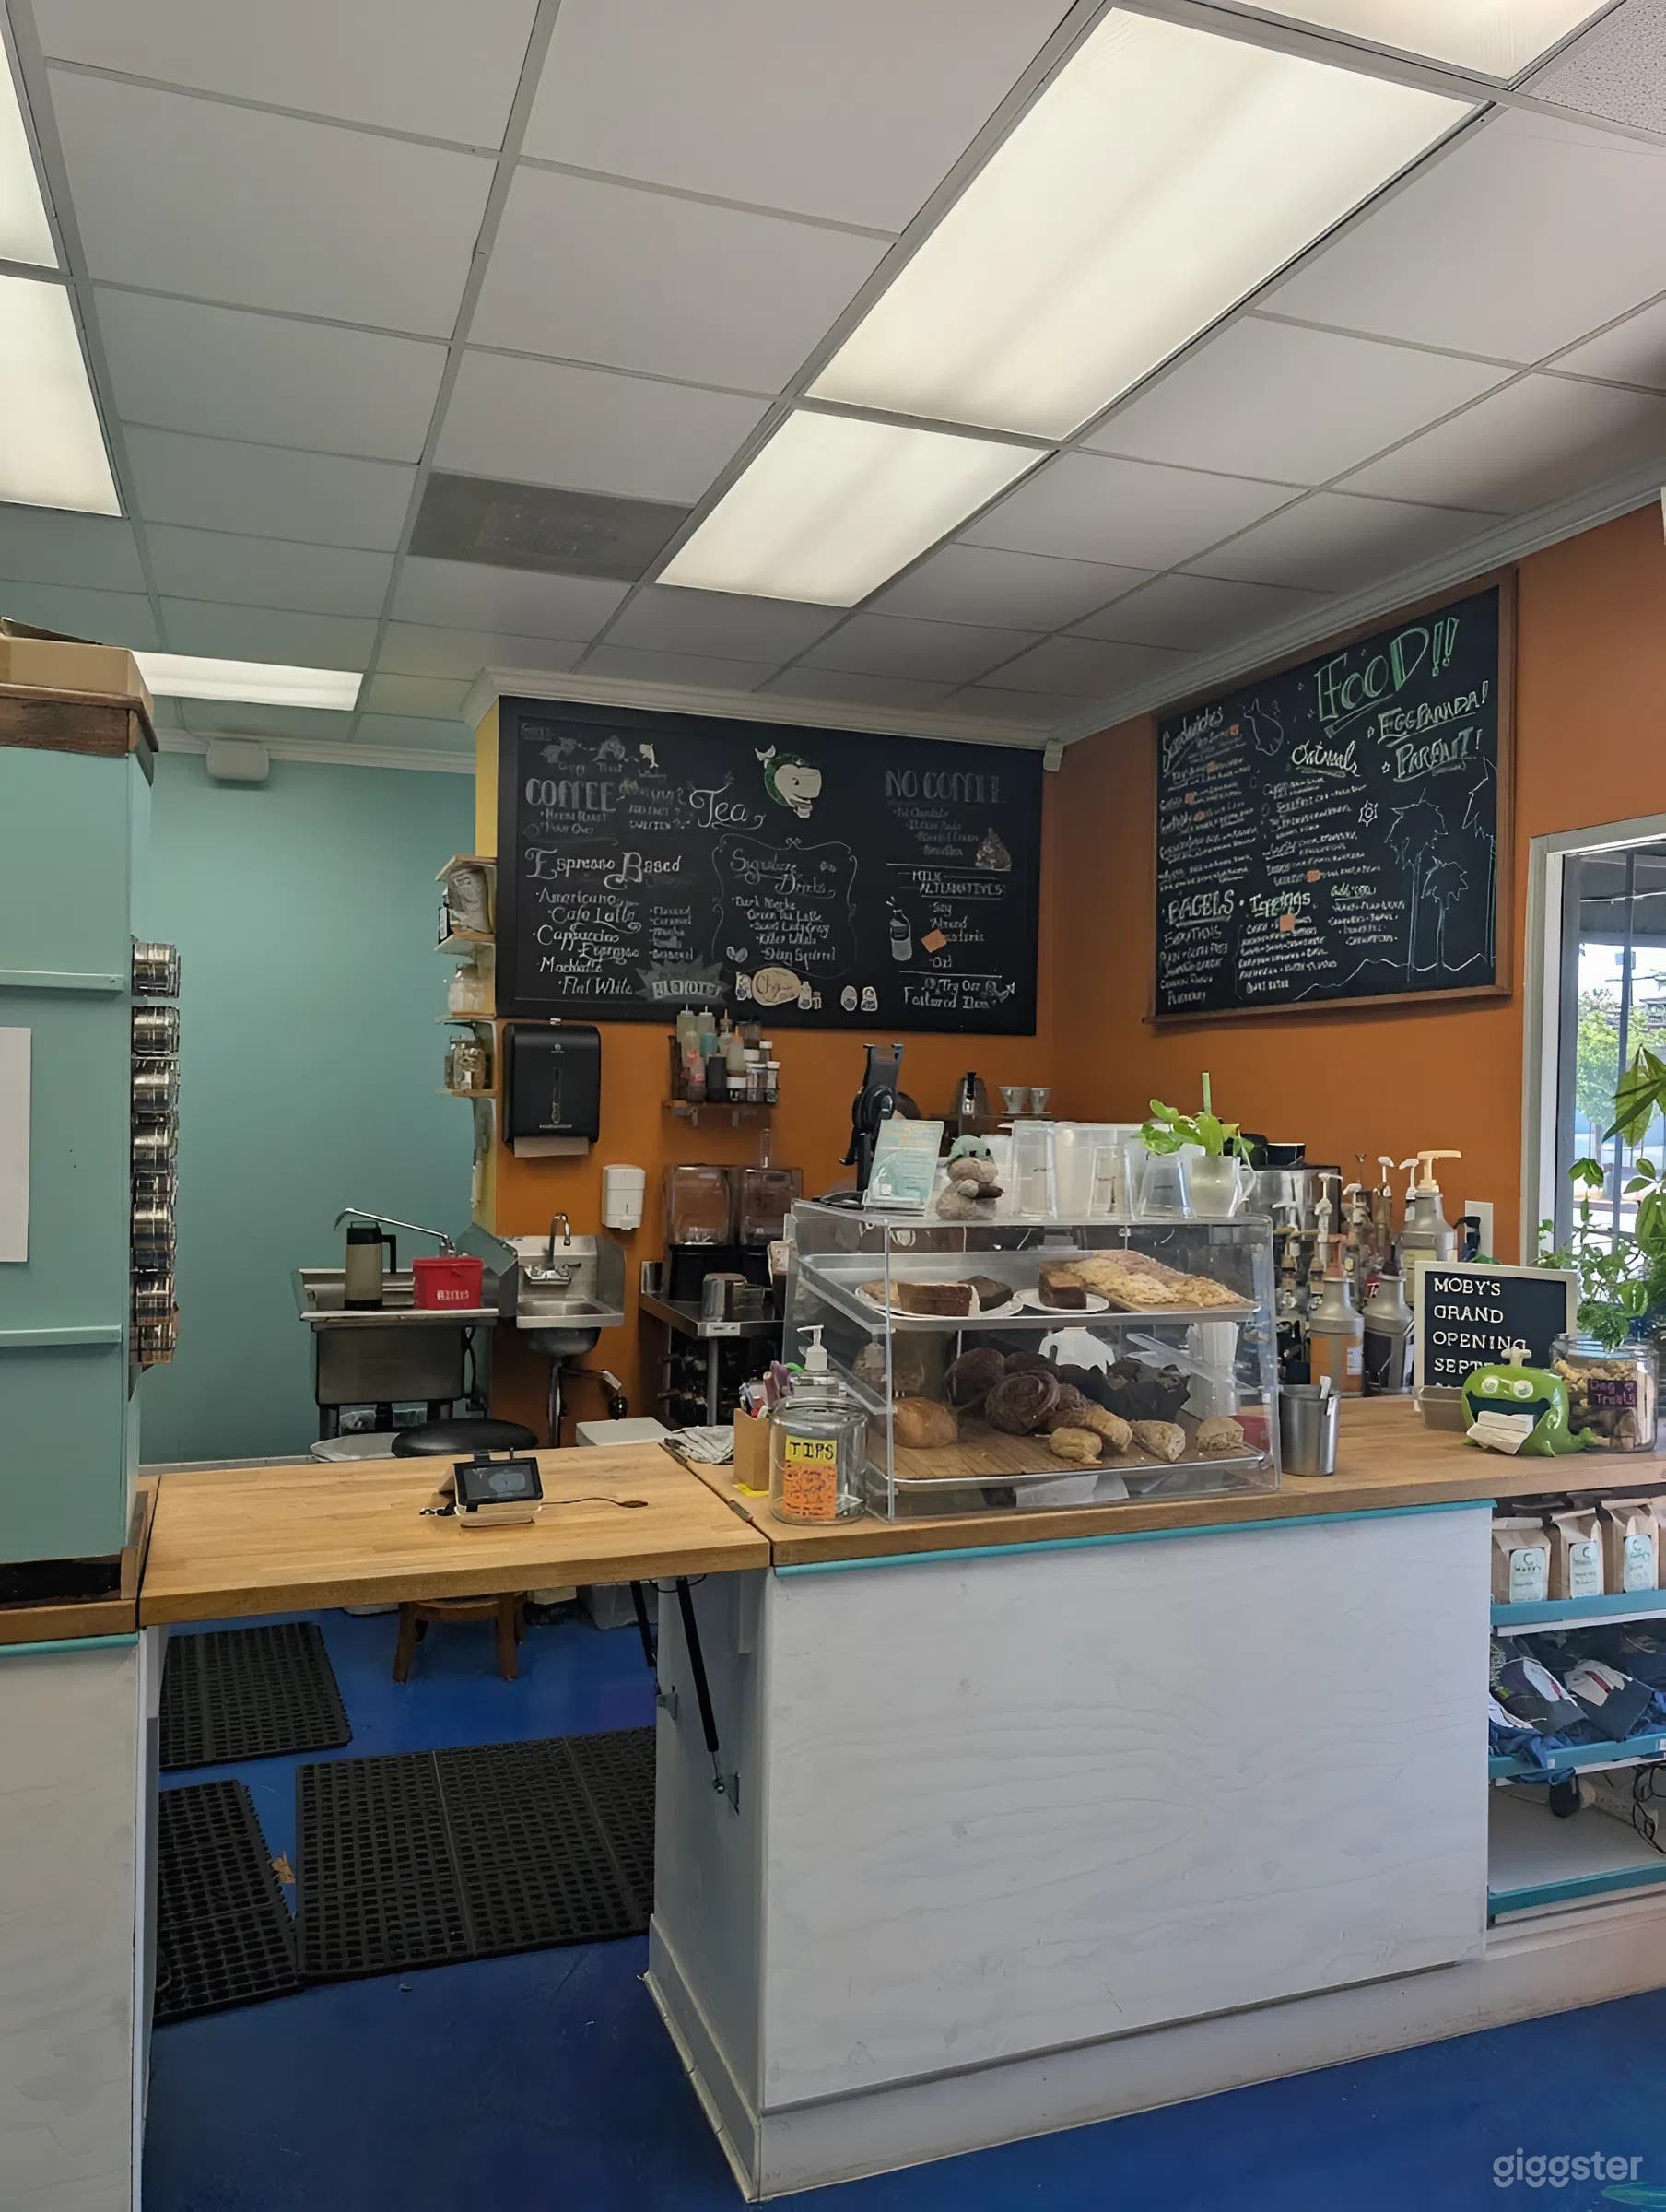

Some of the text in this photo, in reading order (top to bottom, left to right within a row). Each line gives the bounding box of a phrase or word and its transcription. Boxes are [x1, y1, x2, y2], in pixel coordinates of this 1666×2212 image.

[689, 787, 751, 829] Tea
[525, 847, 616, 880] Espresso
[1168, 889, 1235, 925] BAGELS
[1433, 1277, 1501, 1297] MOBY'S
[1433, 1305, 1504, 1324] GRAND
[789, 1441, 834, 1460] TIPS
